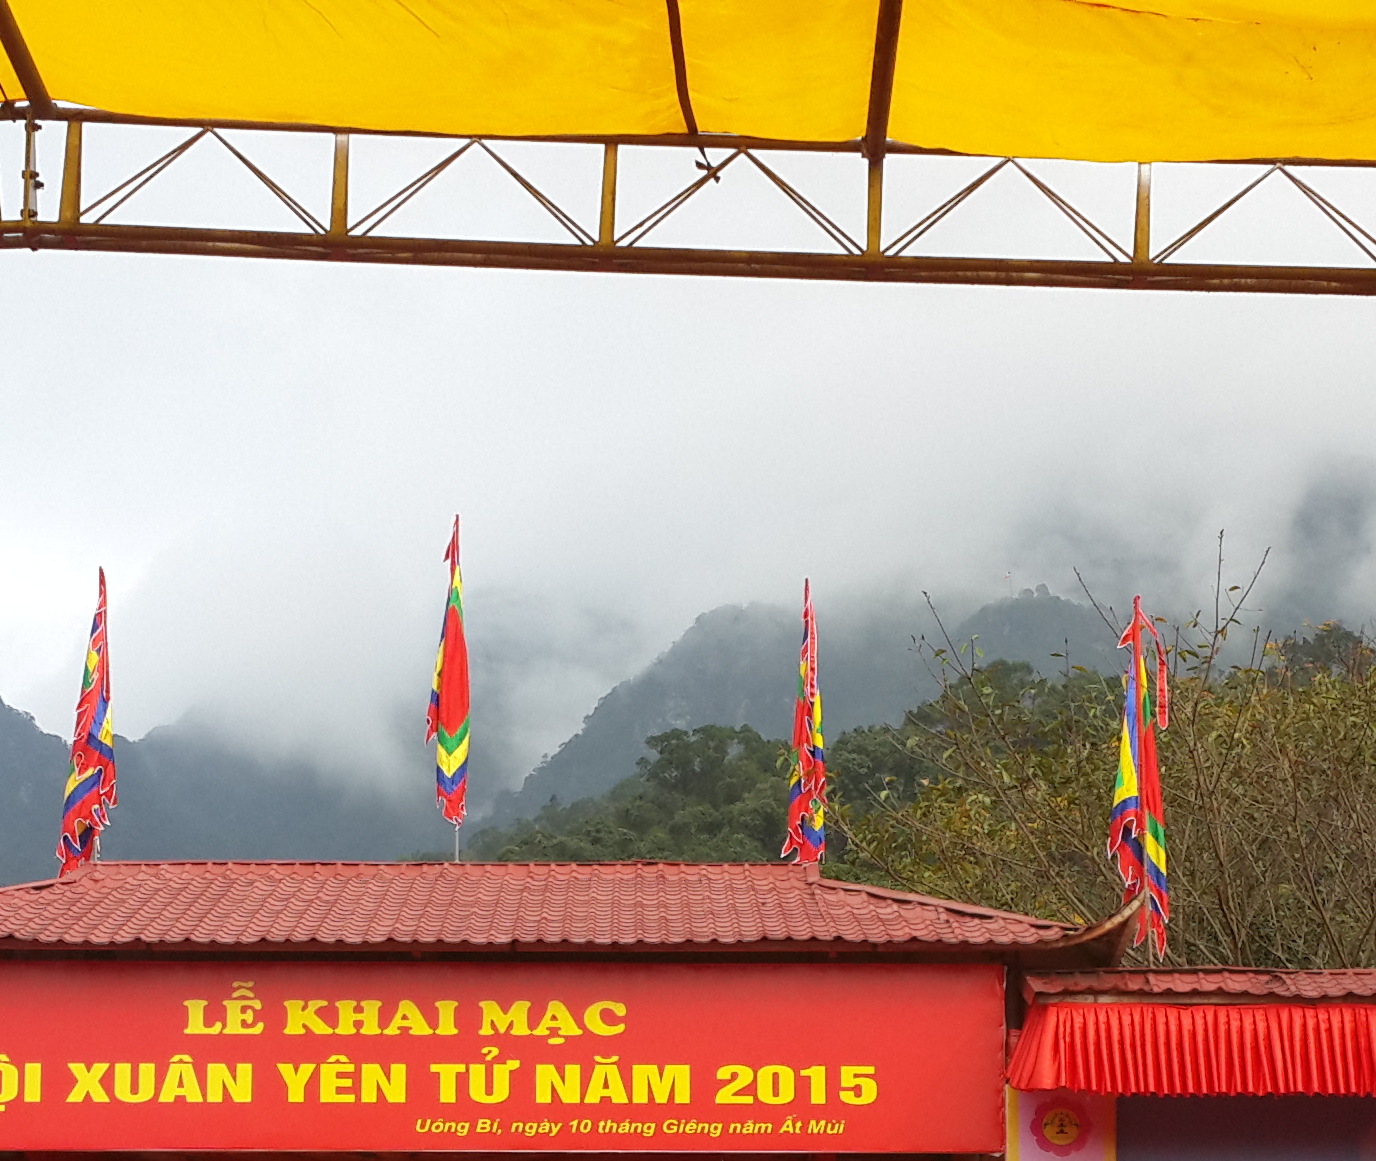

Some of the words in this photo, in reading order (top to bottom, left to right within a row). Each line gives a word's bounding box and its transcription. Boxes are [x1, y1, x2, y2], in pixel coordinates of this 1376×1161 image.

[183, 982, 264, 1035] LỄ
[283, 1000, 459, 1035] KHAI
[478, 1000, 626, 1045] MẠC
[66, 1054, 252, 1103] XUÂN
[276, 1055, 406, 1103] YÊN
[430, 1047, 520, 1103] TỬ
[536, 1056, 690, 1104] NĂM
[715, 1065, 877, 1105] 2015
[416, 1118, 470, 1136] Uông
[476, 1119, 501, 1135] Bí,
[511, 1119, 562, 1136] ngày
[570, 1119, 592, 1133] 10
[598, 1119, 656, 1136] tháng
[663, 1119, 723, 1137] Giêng
[729, 1120, 772, 1134] năm
[808, 1120, 845, 1134] Mùi
